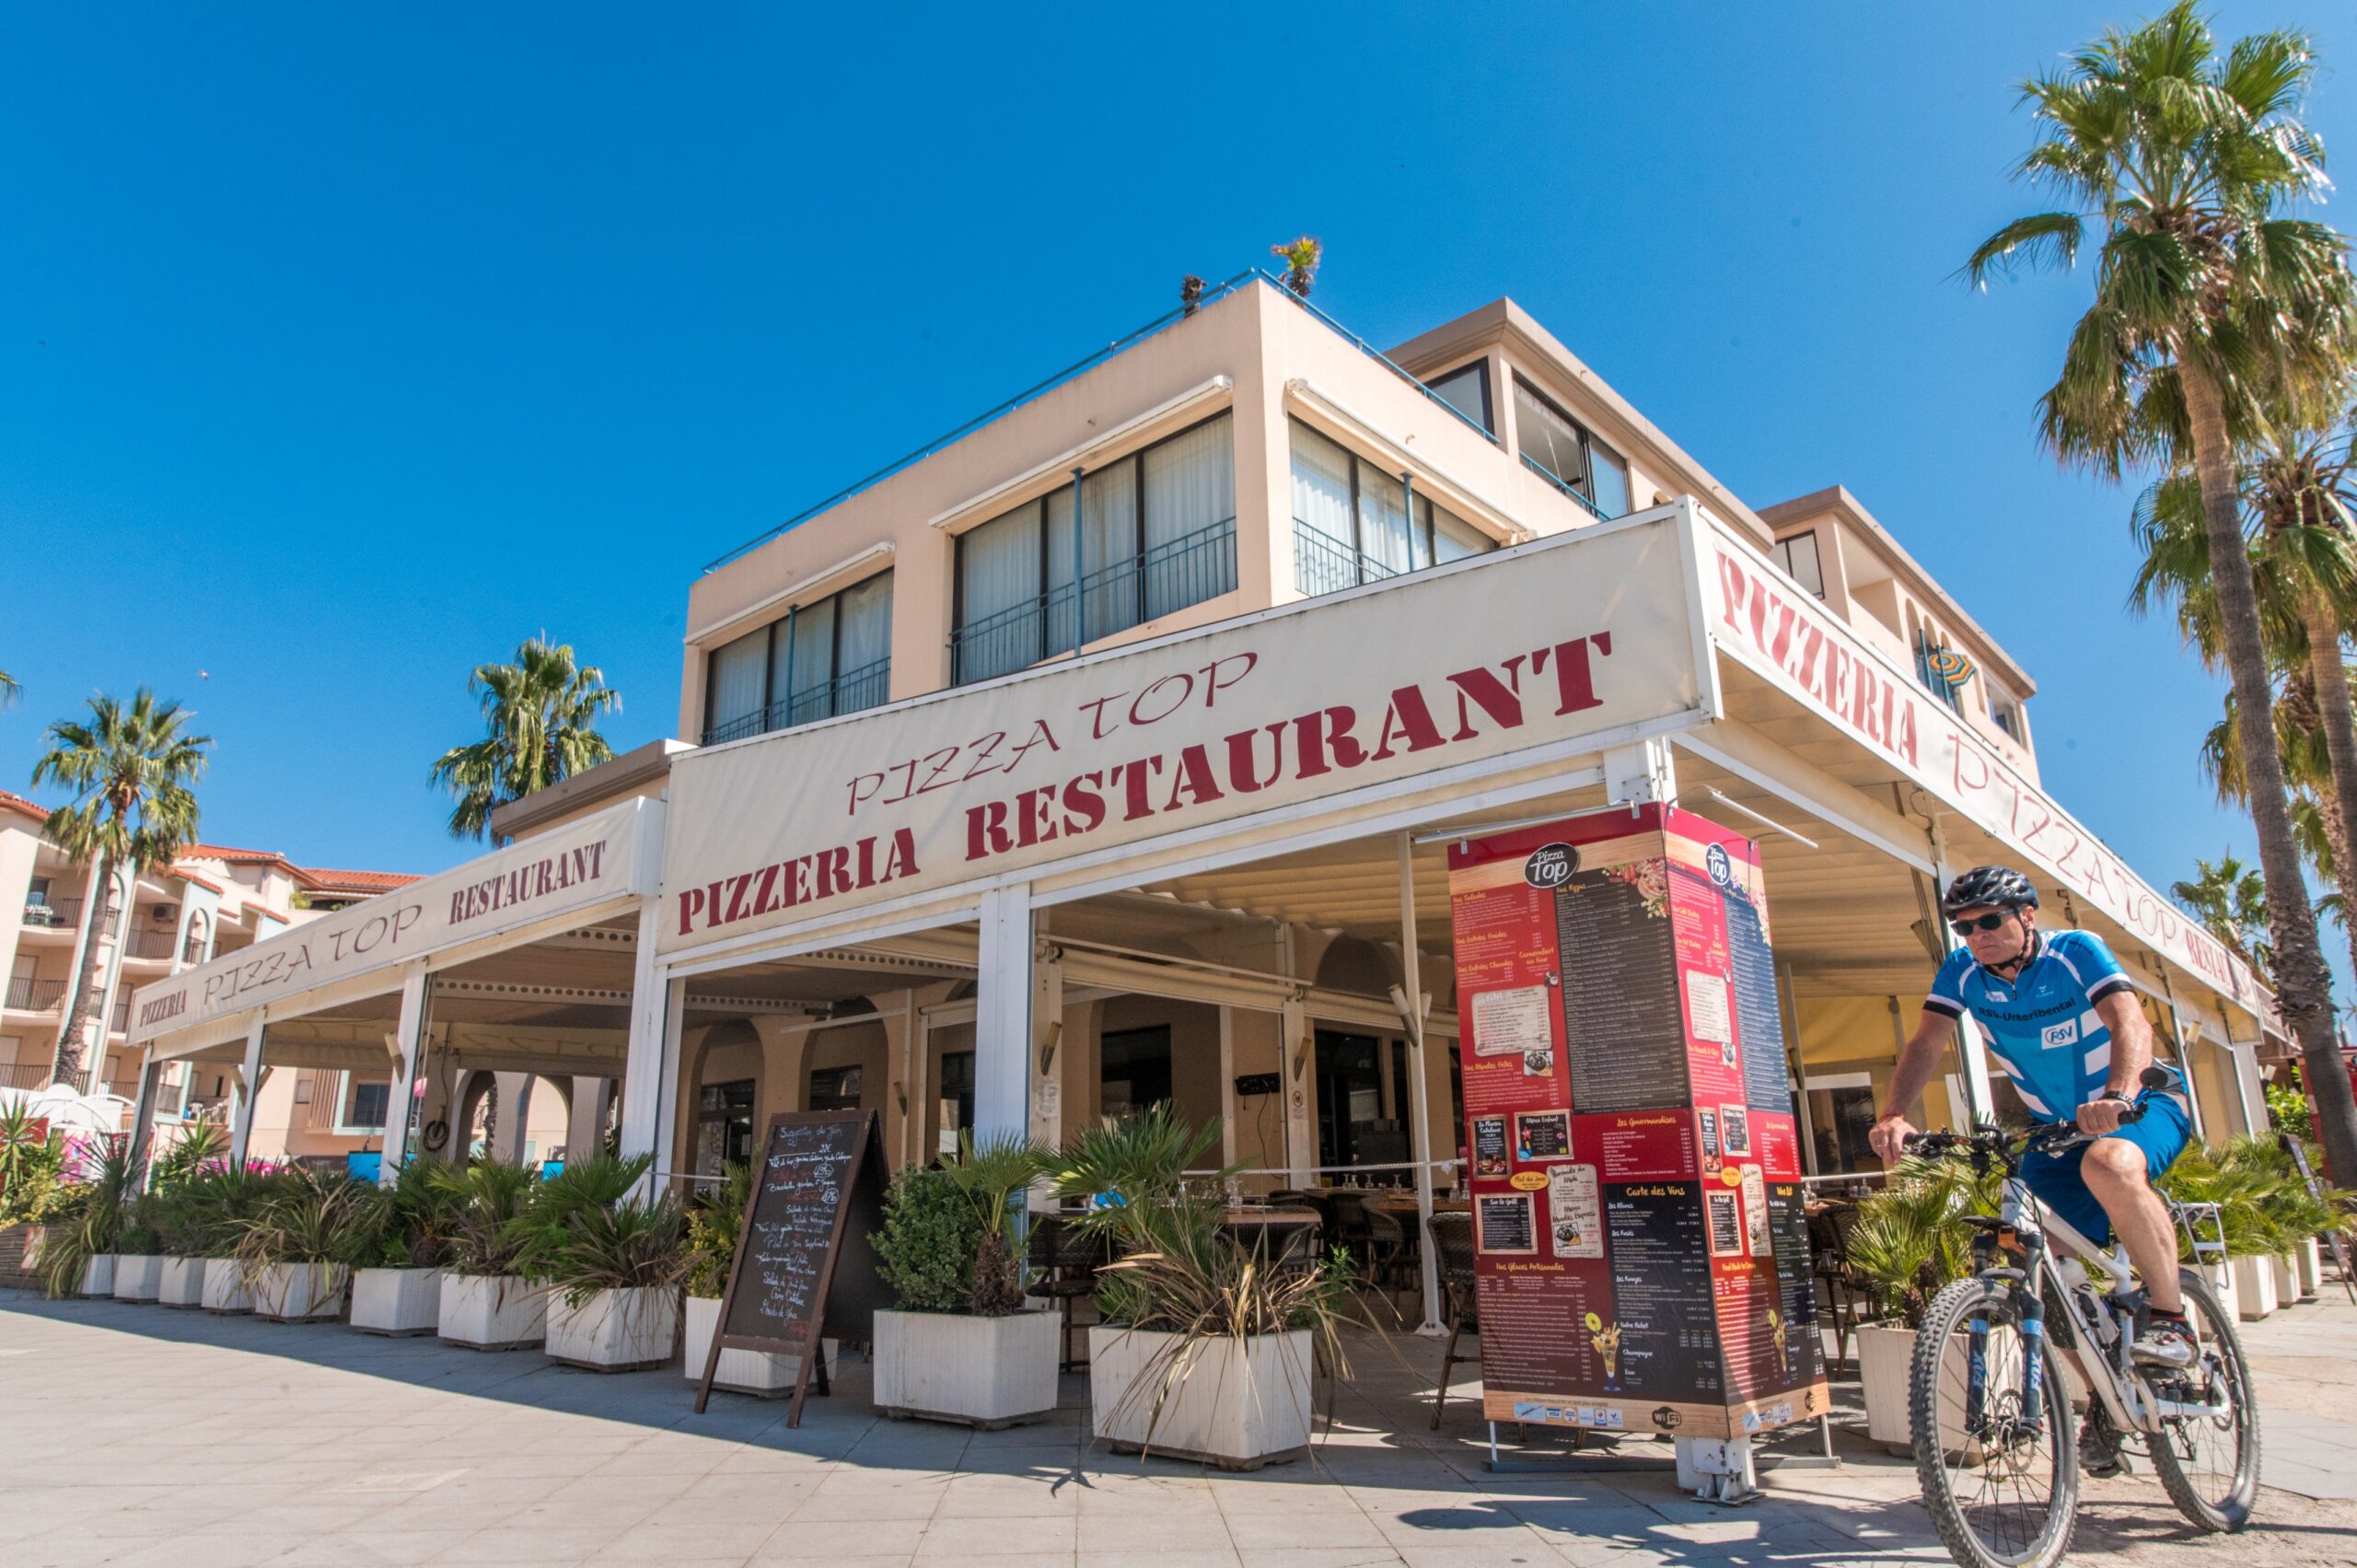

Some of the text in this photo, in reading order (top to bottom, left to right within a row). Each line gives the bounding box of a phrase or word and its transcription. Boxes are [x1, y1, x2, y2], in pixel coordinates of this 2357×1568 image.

[846, 652, 1258, 816] PIZZA TOP
[1715, 549, 1920, 770] PIZZERIA
[1946, 734, 2116, 905] PIZZA
[2114, 868, 2176, 948] TOP
[678, 630, 1613, 936] PIZZERIA RESTAURANT
[1536, 850, 1565, 863] Pizza
[1530, 861, 1568, 883] Top
[1707, 854, 1727, 883] Top
[1464, 891, 1486, 901] Salades
[139, 840, 607, 1028] PIZZERIA PIZZA TOP RESTAURANT
[2050, 1025, 2073, 1042] RSV
[1526, 1115, 1559, 1124] Menu Enfant
[1617, 1115, 1677, 1128] Les Gourmandises
[1626, 1185, 1686, 1197] Carte des Vins
[1528, 1261, 1565, 1272] Artisanales
[1972, 1349, 1984, 1391] FOX
[2030, 1350, 2043, 1391] FOX
